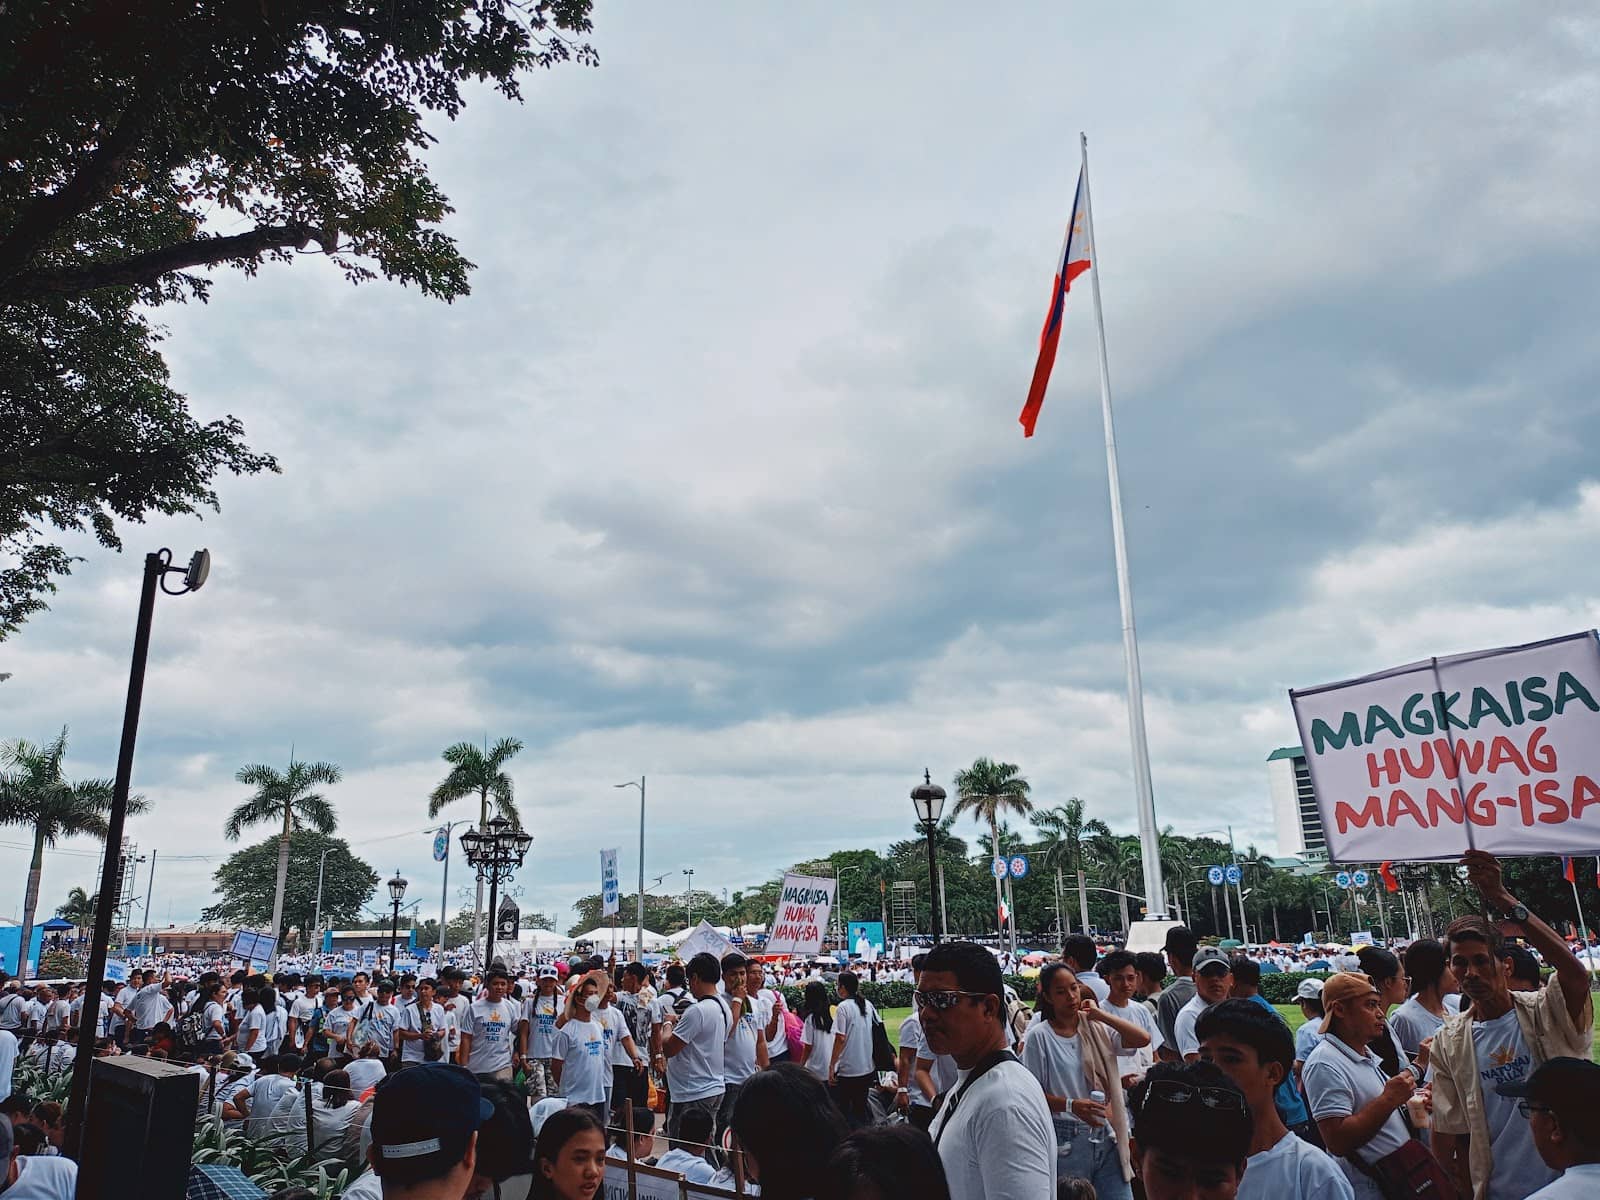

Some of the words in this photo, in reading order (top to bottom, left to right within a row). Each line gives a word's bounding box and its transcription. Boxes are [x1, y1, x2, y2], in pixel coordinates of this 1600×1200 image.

[1311, 671, 1600, 755] MAGKAISA
[1366, 726, 1557, 788] HUWAG
[1335, 776, 1600, 834] MANG-ISA
[1480, 1055, 1530, 1080] NATONAL
